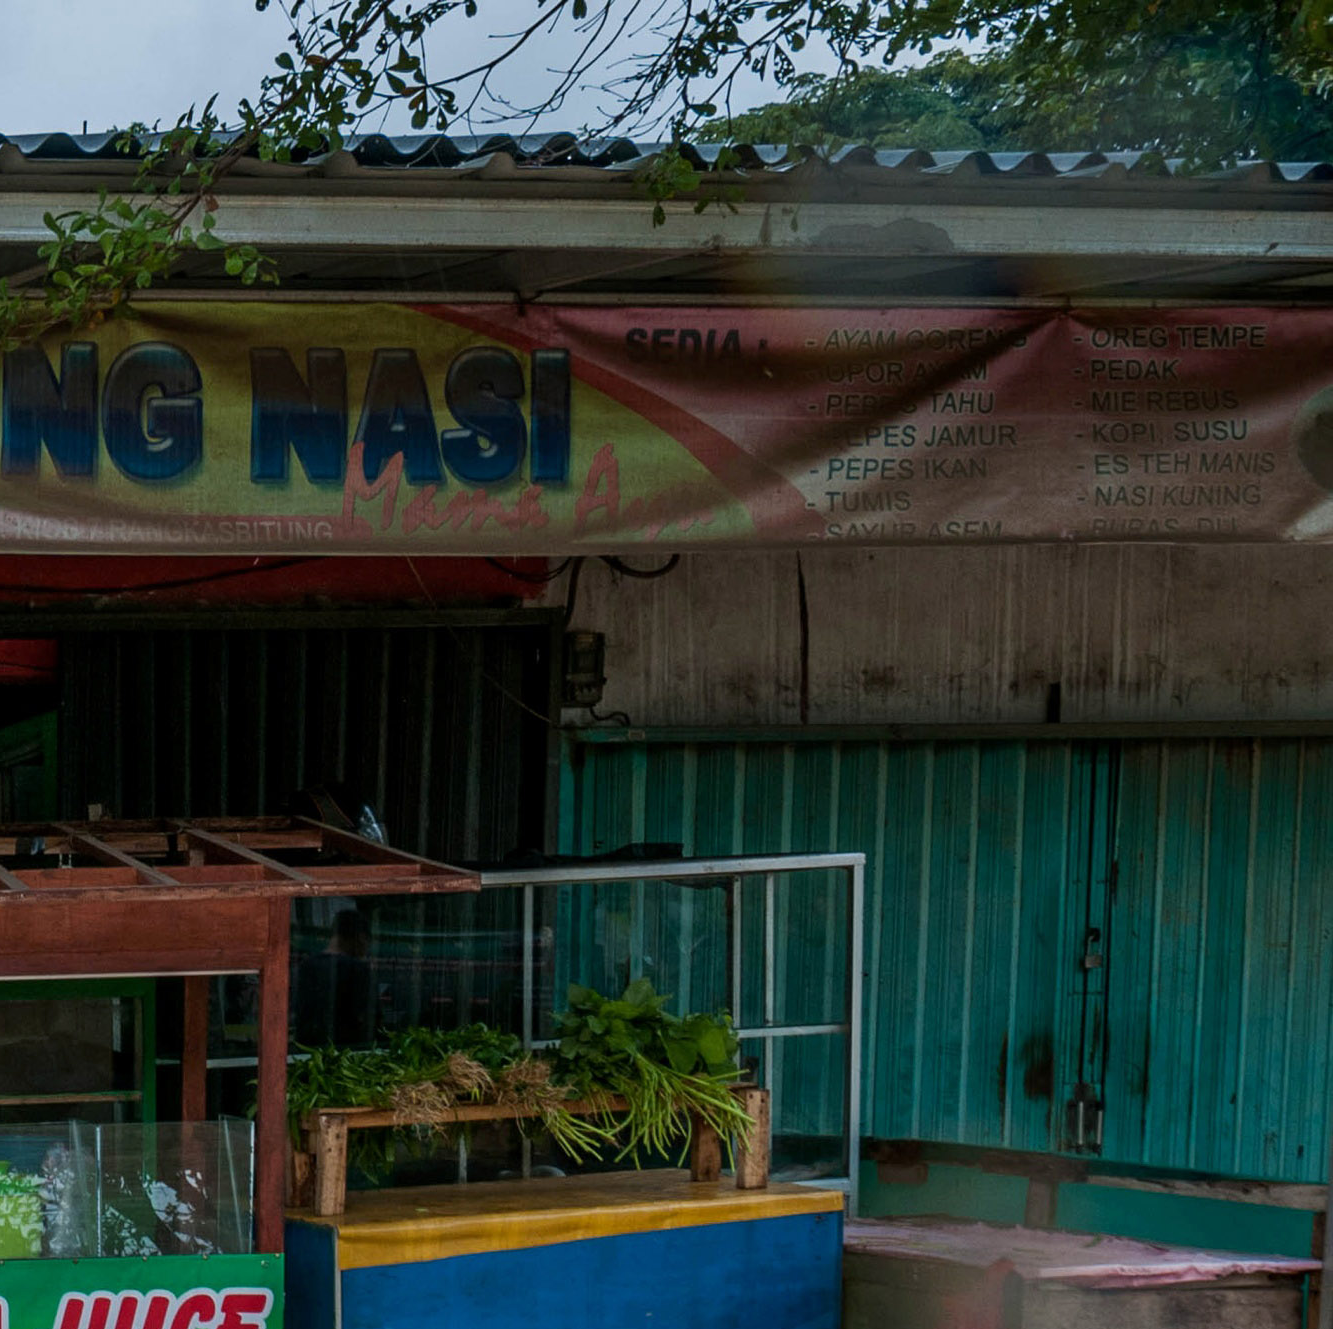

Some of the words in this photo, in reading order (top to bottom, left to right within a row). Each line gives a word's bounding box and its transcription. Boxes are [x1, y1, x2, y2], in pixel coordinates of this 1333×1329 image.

[624, 327, 743, 365] SEDIA
[823, 329, 896, 351] AYAM
[906, 328, 1027, 352] GORENG
[1091, 327, 1168, 348] OREG
[1177, 326, 1266, 348] TEMPE
[827, 361, 903, 384] OPOR
[914, 359, 987, 382] AYM
[1089, 359, 1180, 380] PEDAK
[826, 393, 918, 417] PEPS
[931, 391, 995, 413] TAHU
[1091, 391, 1135, 411] MIE
[1146, 389, 1239, 411] REBUS
[250, 345, 570, 485] NASI
[827, 425, 916, 448] EPES
[924, 424, 1017, 449] JAMUR
[1175, 419, 1248, 442] SUSU
[827, 458, 914, 482] PEPES
[924, 457, 988, 479] IKAN
[1094, 454, 1130, 475] ES
[1138, 453, 1191, 474] TEH
[1198, 452, 1275, 474] MANIS
[825, 490, 912, 513] TUMIS
[1094, 487, 1154, 507] NASI
[1162, 484, 1262, 506] KUNING
